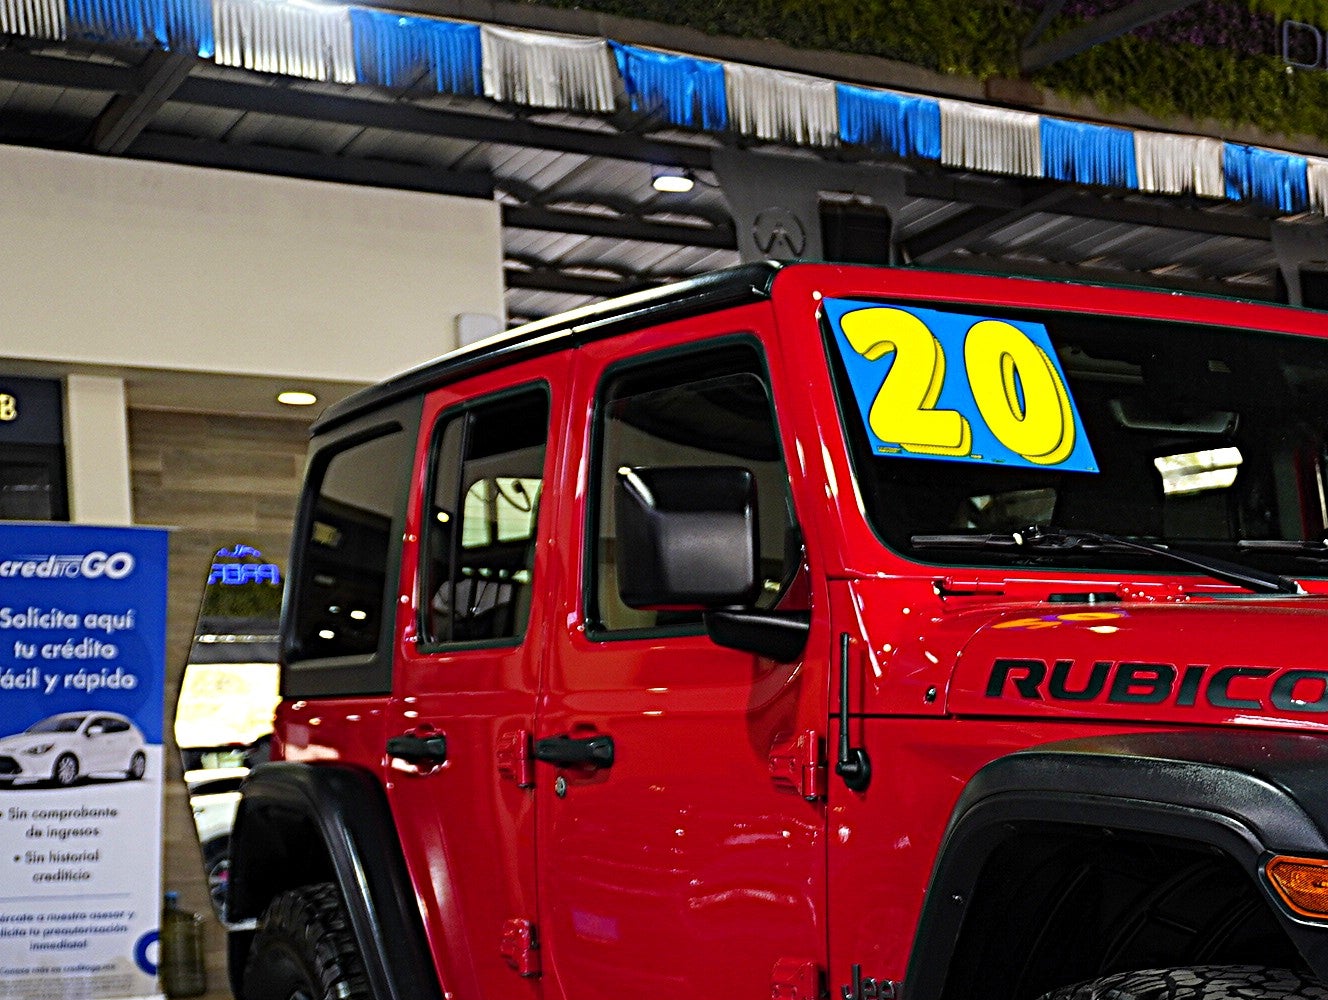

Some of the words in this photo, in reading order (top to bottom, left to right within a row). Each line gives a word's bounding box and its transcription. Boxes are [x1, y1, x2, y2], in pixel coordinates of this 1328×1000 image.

[840, 307, 1077, 466] 20
[0, 606, 80, 629] Solicita
[83, 608, 137, 634] aquí
[14, 640, 37, 660] tu
[41, 637, 118, 660] crédito
[0, 666, 40, 690] ácil
[44, 674, 60, 695] y
[63, 667, 138, 693] rápido
[8, 806, 28, 821] Sin
[31, 804, 119, 822] comprobante
[25, 825, 43, 839] de
[46, 825, 100, 841] ingresos
[24, 850, 45, 865] Sin
[48, 848, 101, 864] historial
[32, 868, 92, 883] crediticio
